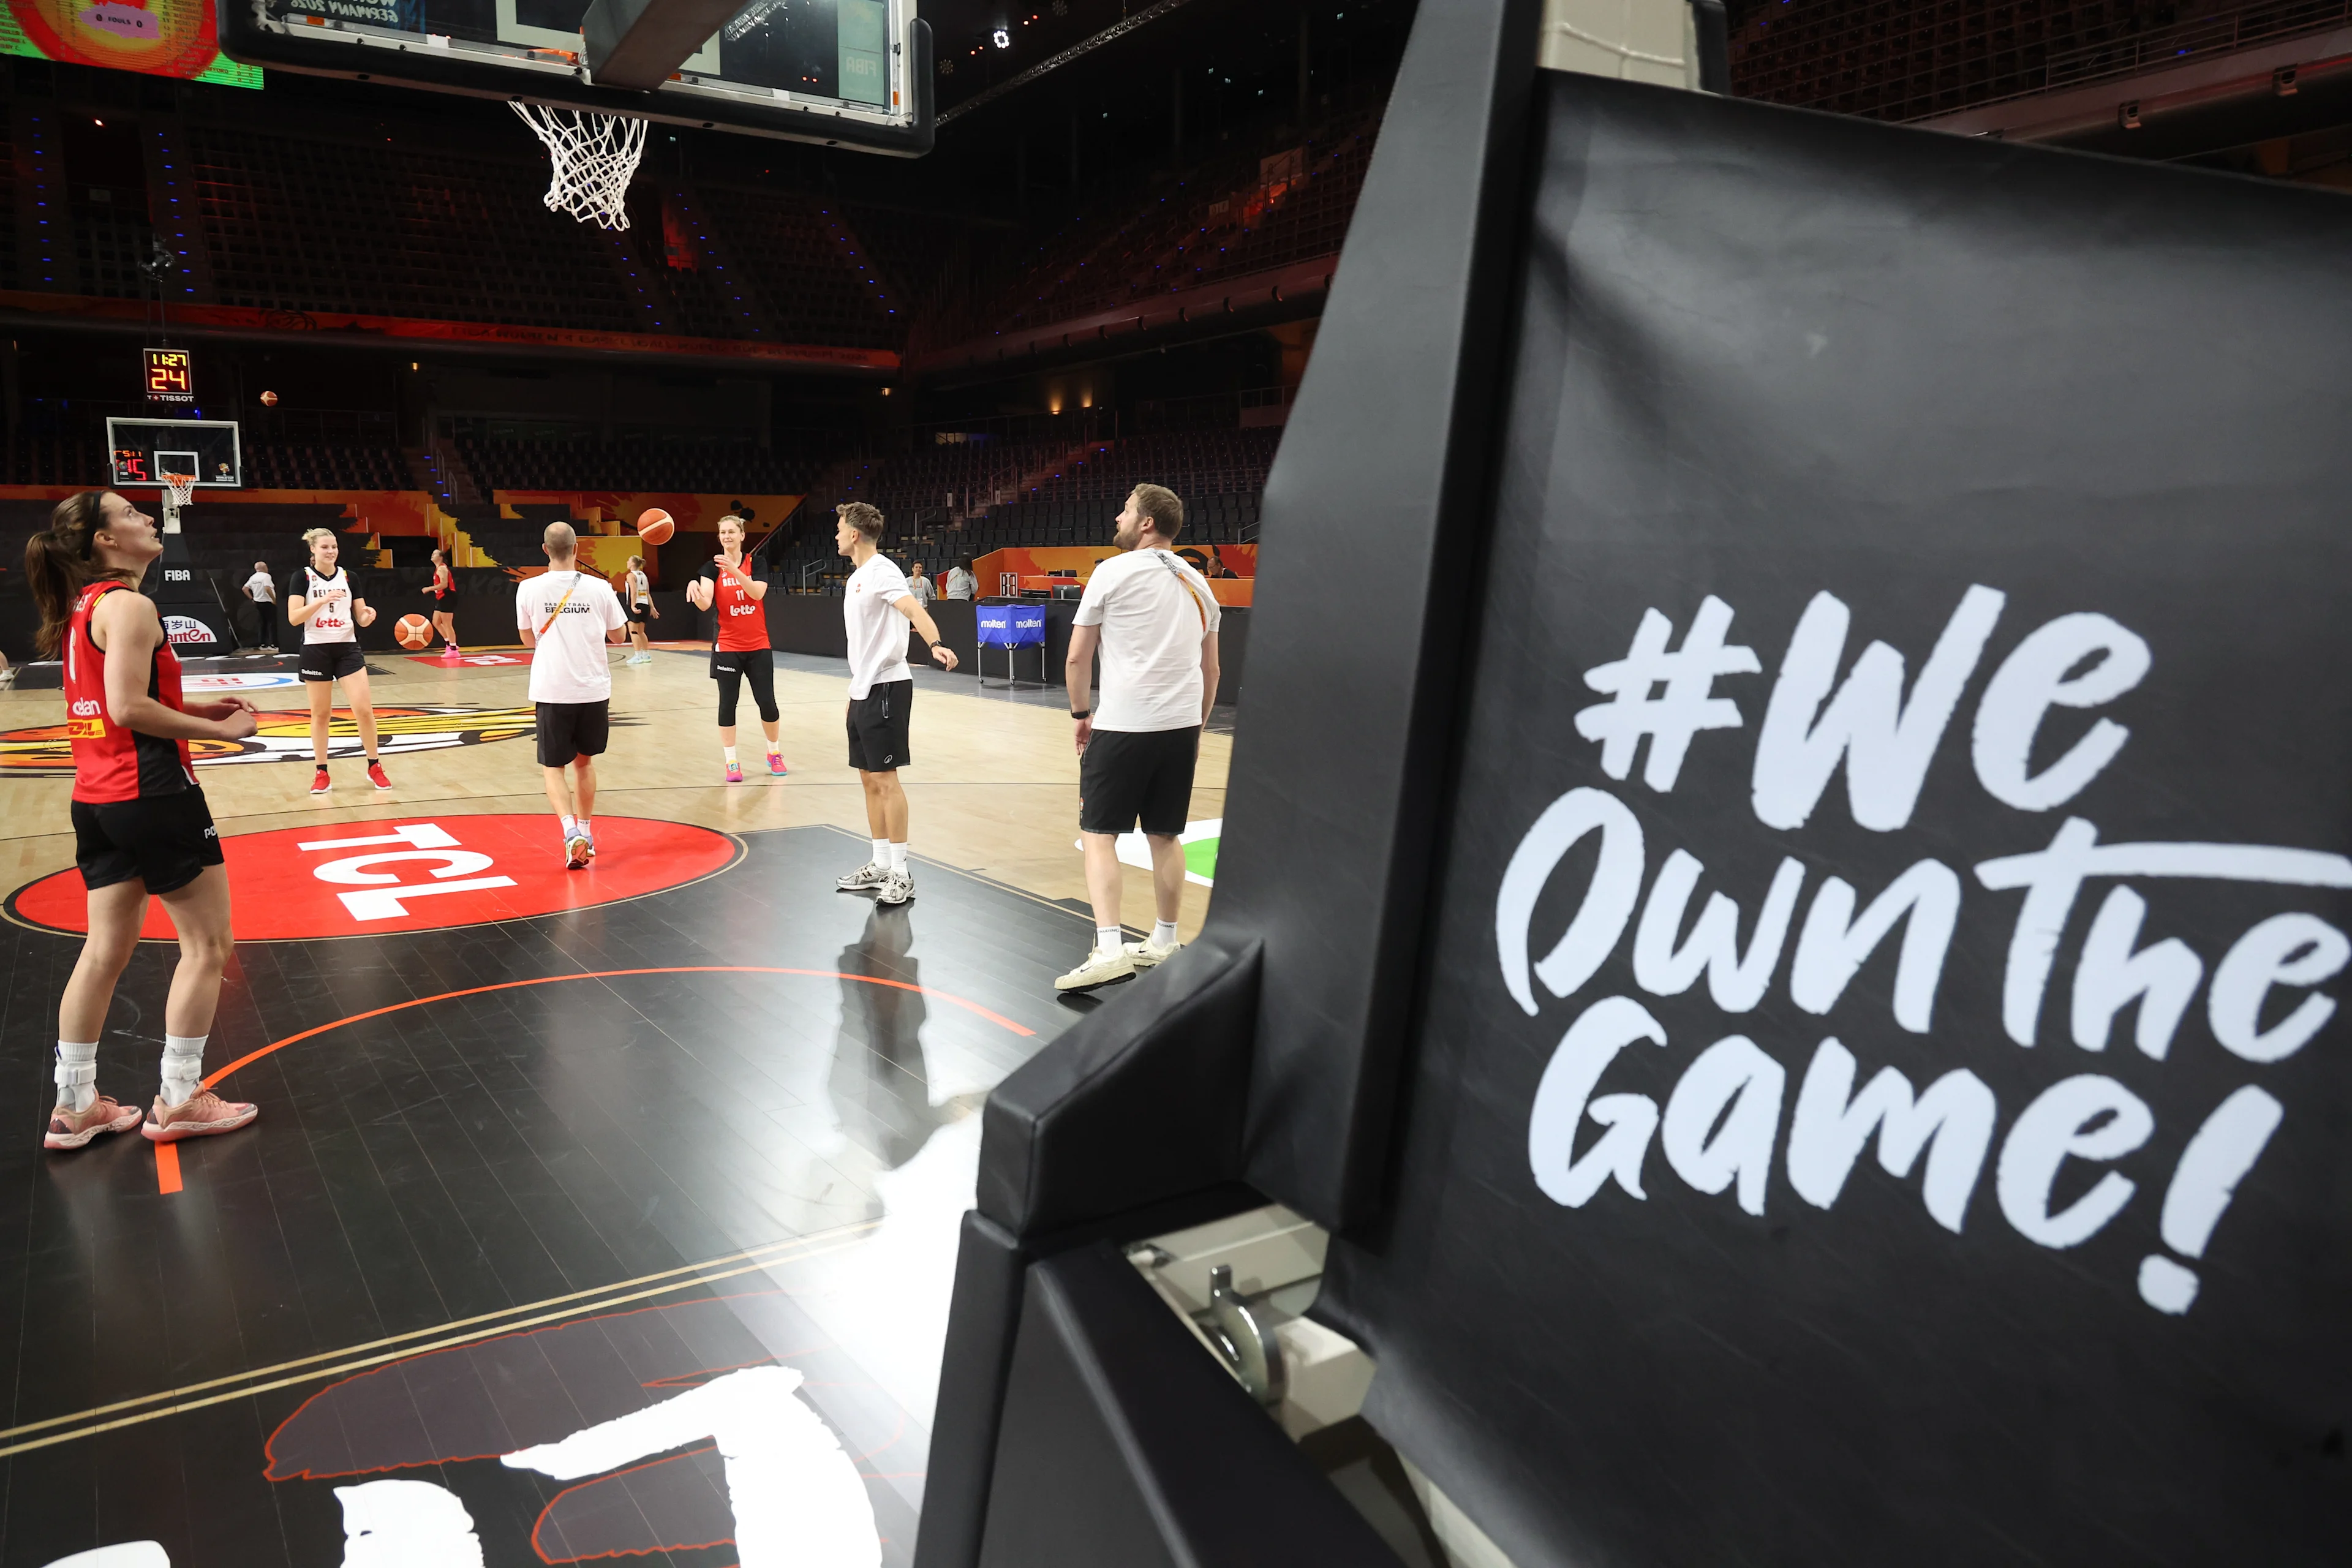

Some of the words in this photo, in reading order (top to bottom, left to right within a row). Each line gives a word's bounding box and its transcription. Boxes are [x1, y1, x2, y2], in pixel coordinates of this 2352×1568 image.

[108, 16, 131, 25] FOULS
[153, 353, 187, 366] 11:27
[151, 368, 187, 390] 24
[164, 570, 190, 581] FIBA
[736, 589, 745, 601] 11
[329, 602, 334, 613] 5
[981, 619, 1006, 628] molten
[1016, 619, 1042, 628] molten
[167, 628, 211, 642] anten
[1574, 584, 2152, 831] #We
[296, 823, 519, 922] TCL
[1496, 787, 1961, 1033] Own
[1528, 995, 2285, 1314] Game!
